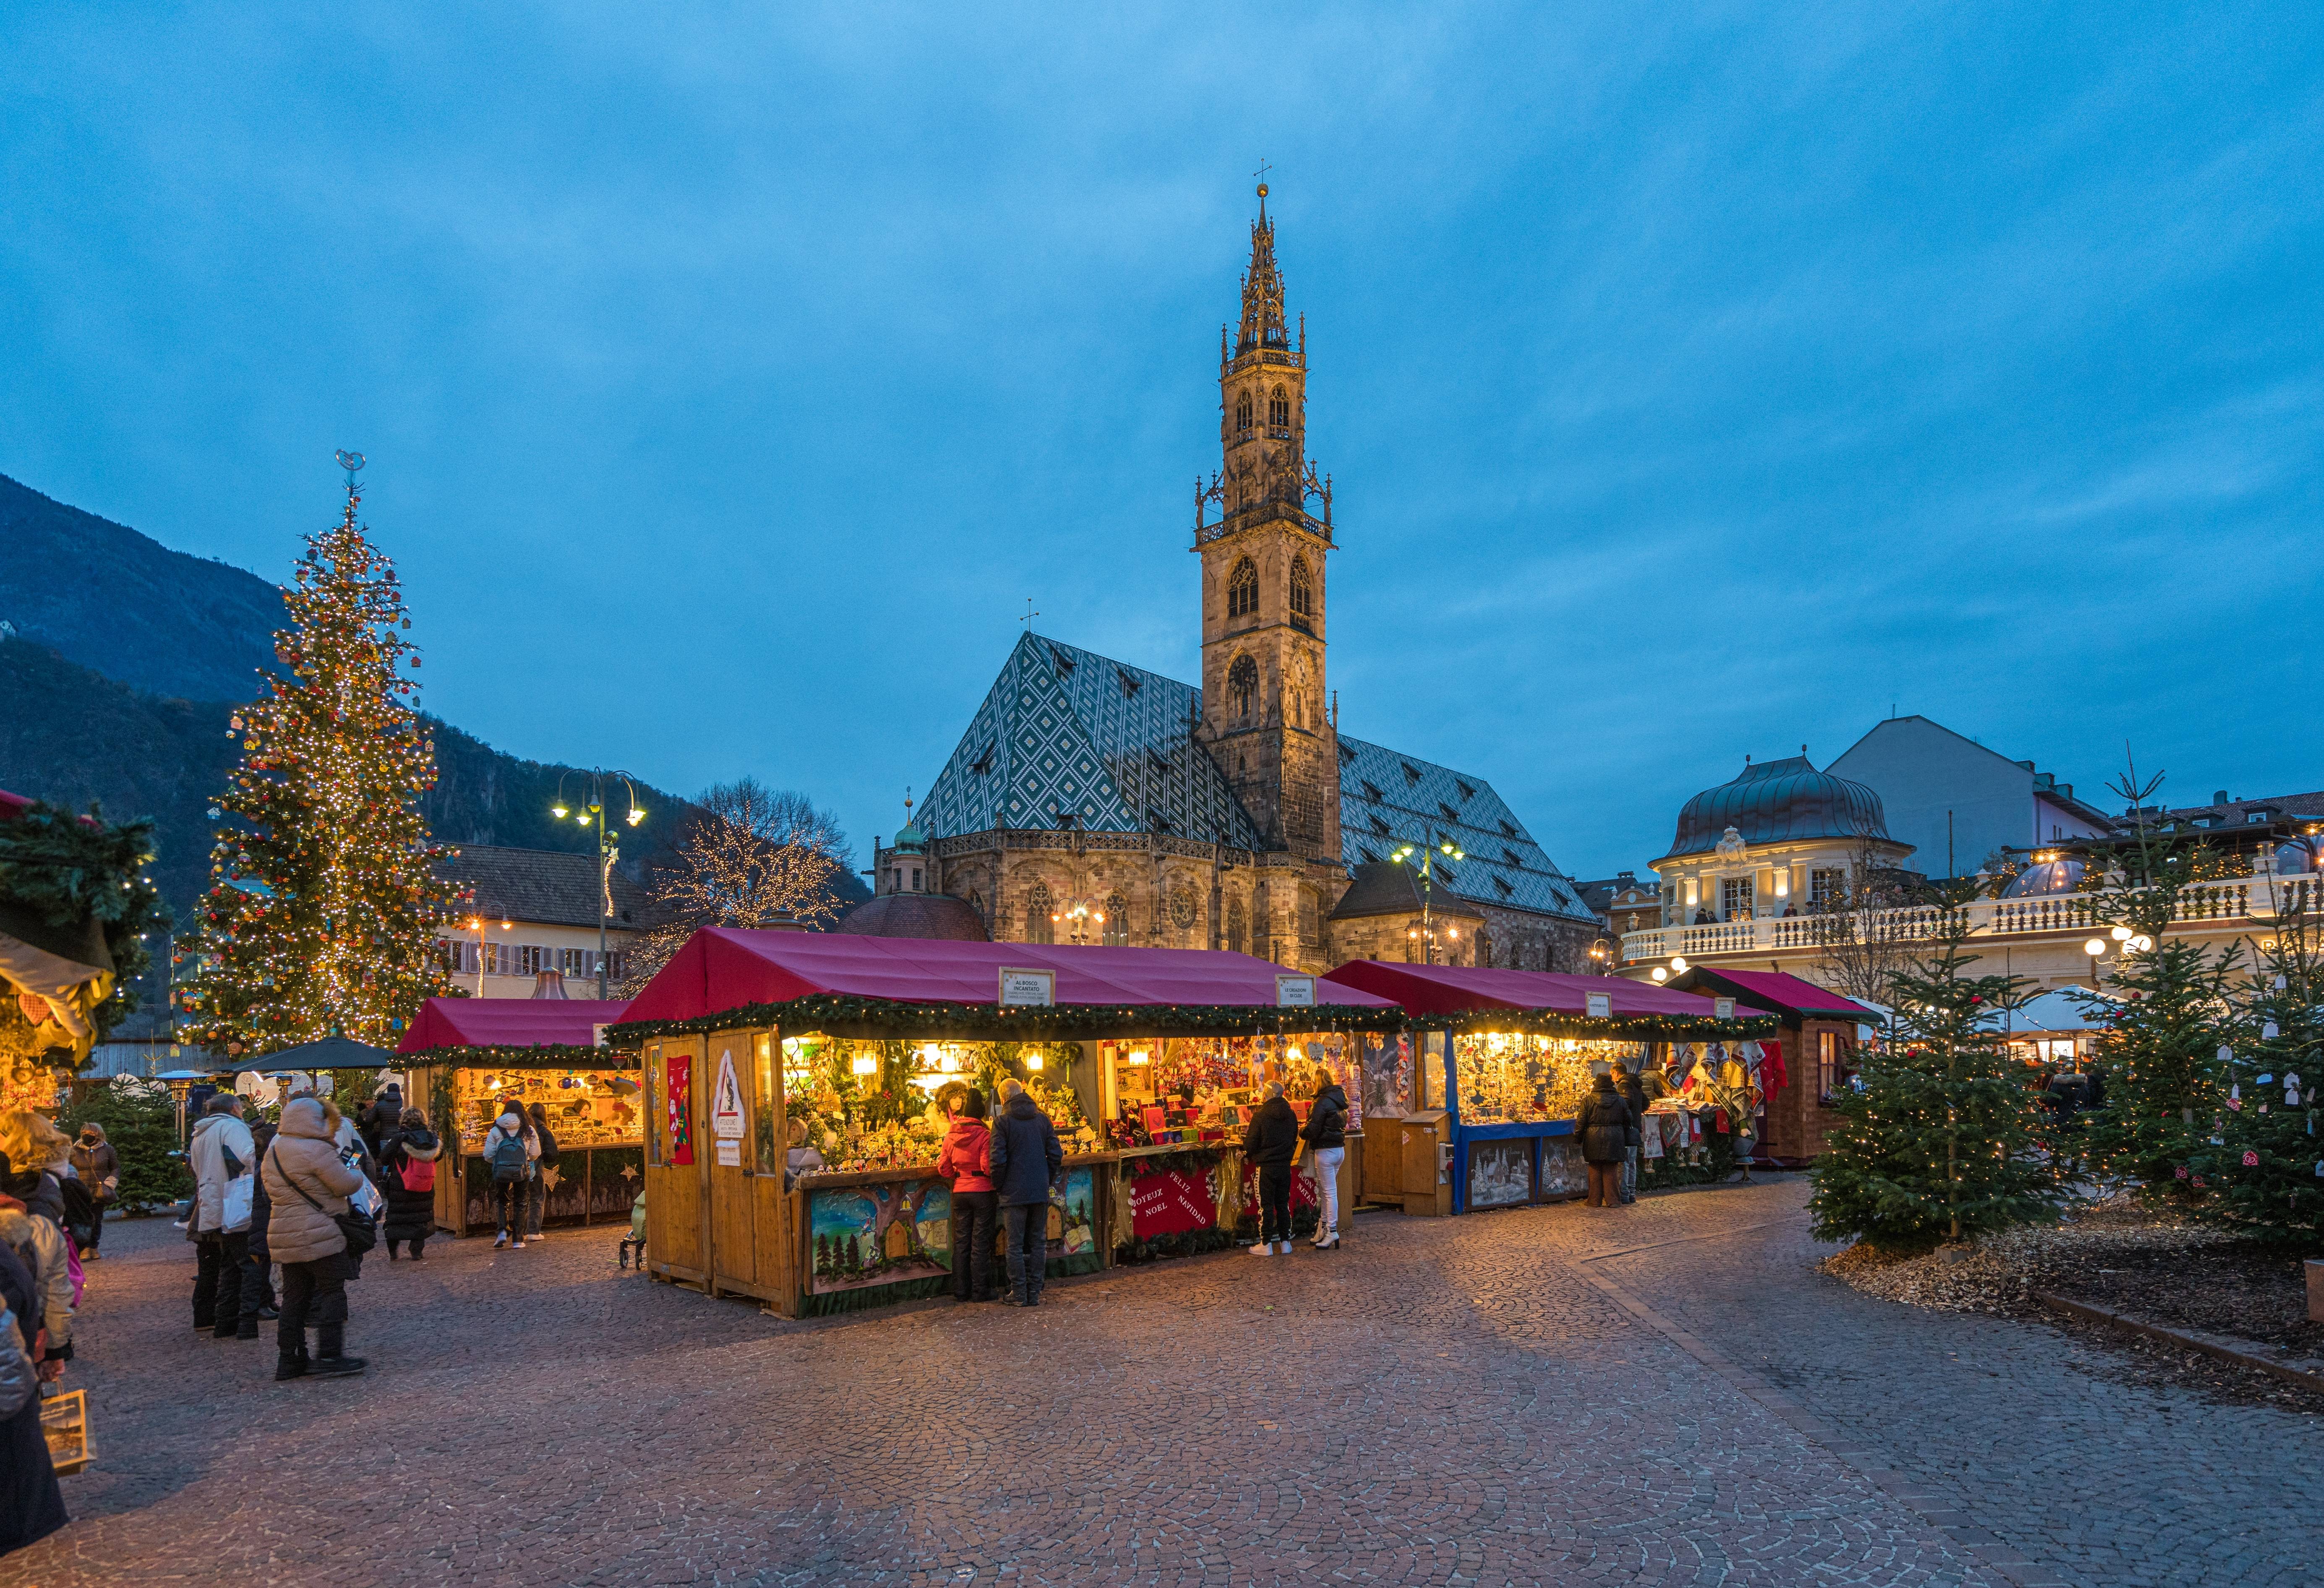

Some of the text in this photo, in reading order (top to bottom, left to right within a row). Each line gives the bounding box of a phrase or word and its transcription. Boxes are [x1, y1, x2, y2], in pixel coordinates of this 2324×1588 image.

[1169, 1171, 1191, 1193] FELIZ
[1298, 1171, 1313, 1189] BUON
[1133, 1188, 1163, 1207] JOYEUX
[1145, 1202, 1168, 1217] NOEL
[1178, 1195, 1206, 1225] NAVIDAD
